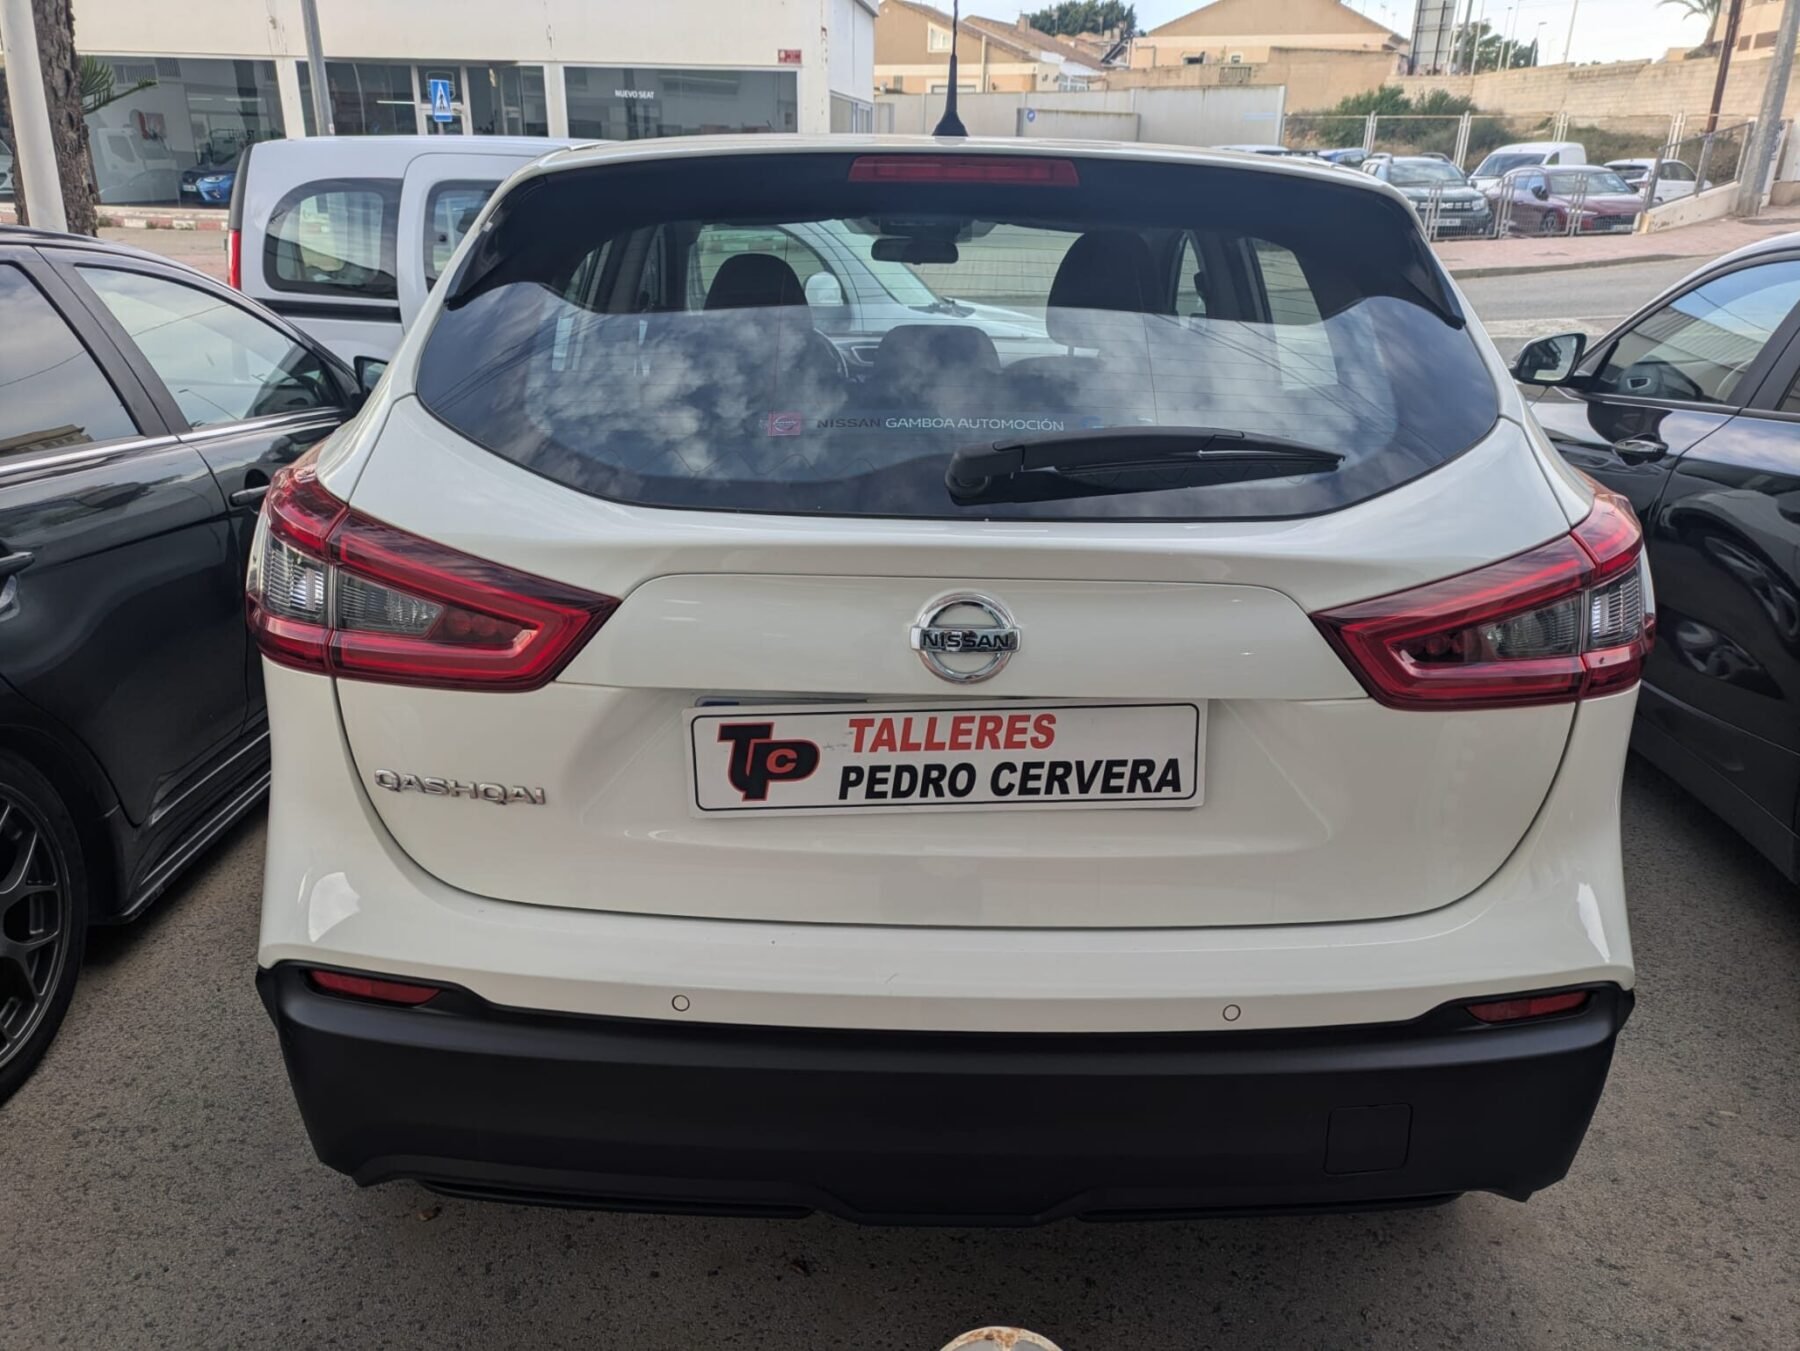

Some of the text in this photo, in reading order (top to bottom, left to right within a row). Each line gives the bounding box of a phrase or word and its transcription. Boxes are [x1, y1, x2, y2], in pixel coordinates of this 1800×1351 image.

[615, 89, 654, 99] NUEVO SEAT
[817, 418, 1064, 431] NISSAN GAMBOA AUTOMOCIÓN
[922, 633, 1009, 648] NISSAN
[849, 713, 1057, 753] TALLERES
[375, 769, 546, 805] QASHQAI
[838, 758, 1181, 800] PEDRO CERVERA
